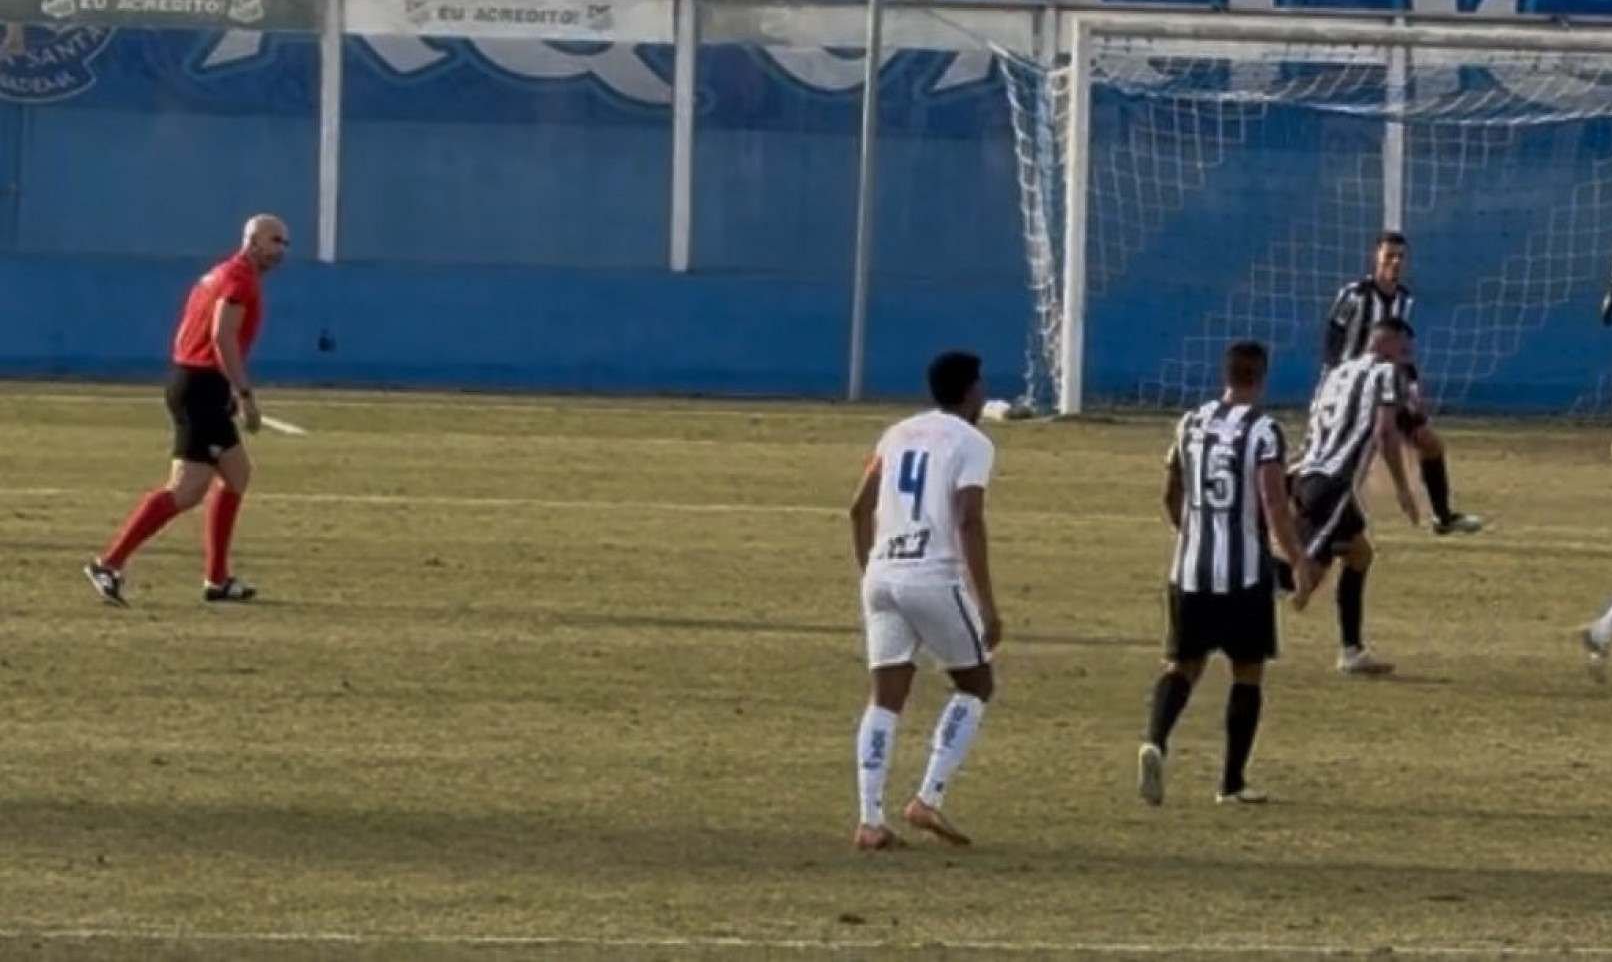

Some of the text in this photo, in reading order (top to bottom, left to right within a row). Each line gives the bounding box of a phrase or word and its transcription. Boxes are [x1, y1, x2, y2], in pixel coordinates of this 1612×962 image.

[437, 4, 464, 20] EU
[897, 449, 930, 522] 4
[1186, 442, 1235, 508] 15
